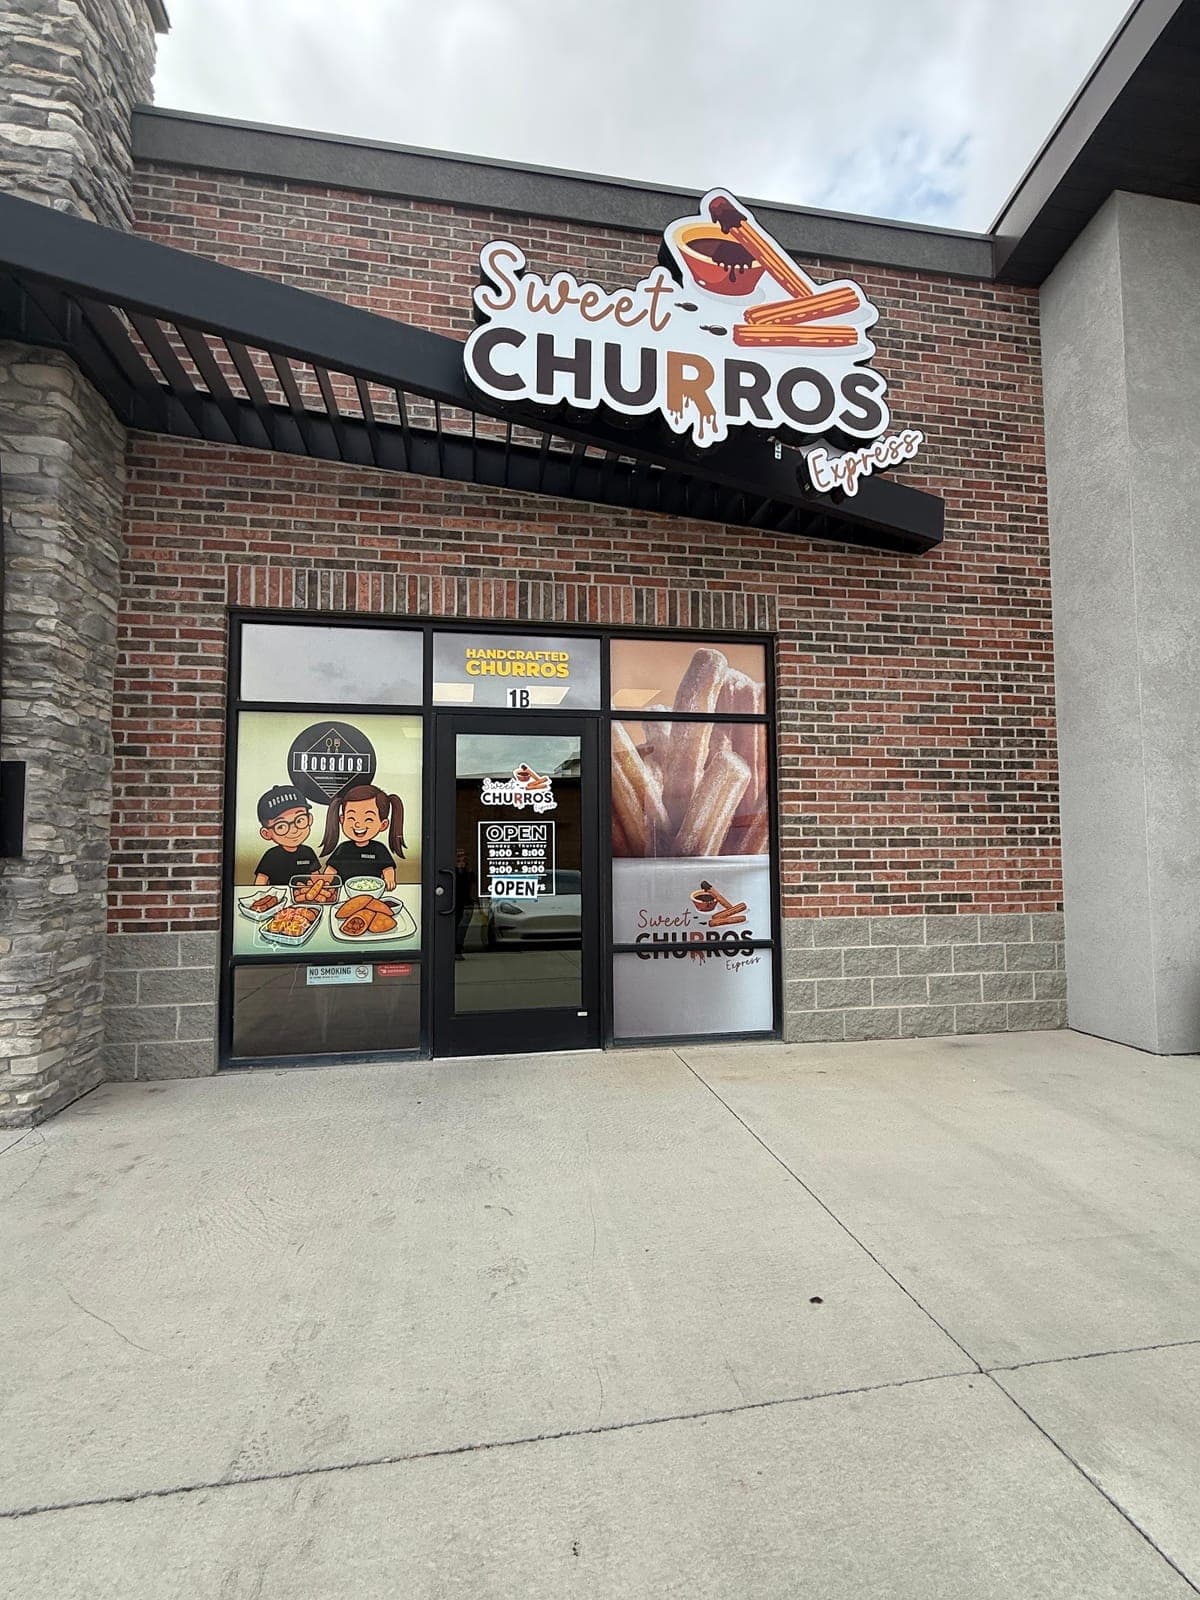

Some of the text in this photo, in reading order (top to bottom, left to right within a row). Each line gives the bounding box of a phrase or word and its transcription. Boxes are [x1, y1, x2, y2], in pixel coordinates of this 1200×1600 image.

[481, 248, 674, 333] Sweet
[471, 326, 883, 438] CHURROS
[812, 434, 919, 491] Express
[465, 648, 569, 662] HANDCRAFTED
[465, 660, 570, 678] CHURROS
[509, 689, 530, 708] 1B
[301, 753, 363, 772] Bocados
[482, 778, 516, 790] Sweet
[482, 792, 553, 805] CHURROS
[486, 825, 547, 842] OPEN
[489, 849, 512, 857] 9:00
[521, 848, 545, 857] 8:00
[489, 866, 512, 874] 9:00
[521, 865, 545, 873] 9:00
[494, 880, 535, 897] OPEN
[637, 908, 692, 929] Sweet
[635, 930, 755, 961] CHURROS
[309, 967, 352, 976] NO SMOKING
[725, 956, 761, 973] Express
